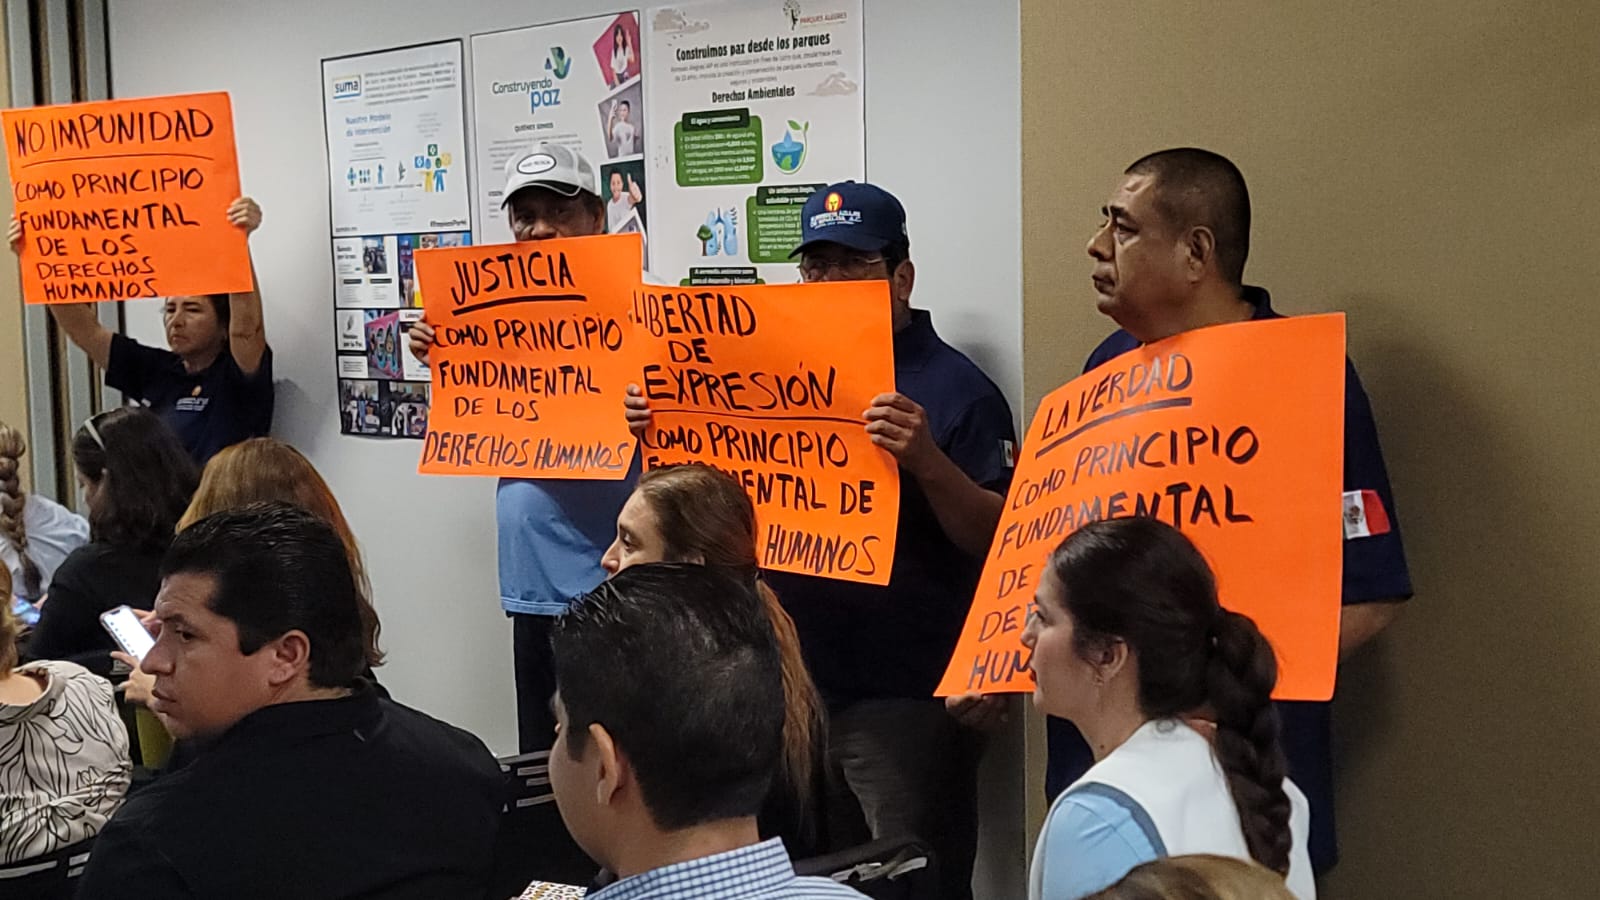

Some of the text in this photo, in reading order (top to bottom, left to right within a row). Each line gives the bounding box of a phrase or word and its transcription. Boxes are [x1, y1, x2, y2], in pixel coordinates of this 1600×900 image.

[676, 45, 728, 61] Construimos
[730, 43, 745, 57] paz
[748, 38, 774, 54] desde
[777, 36, 790, 50] los
[793, 33, 830, 48] parques
[335, 80, 359, 93] suma
[492, 76, 552, 94] Construyendo
[531, 89, 561, 114] paz
[712, 85, 795, 103] Derechos Ambientales
[15, 108, 213, 157] NO IMPUNIDAD
[15, 168, 203, 202] COMO PRINCIPIO
[20, 203, 200, 235] FUNDAMENTAL
[37, 234, 138, 256] DE LOS
[36, 256, 155, 280] DERECHOS
[451, 251, 575, 306] JUSTICIA
[44, 278, 159, 300] HUMANOS
[632, 289, 757, 337] LIBERTAD
[432, 312, 623, 351] COMO PRINCIPIO
[668, 338, 713, 363] DE
[438, 360, 602, 398] FUNDAMENTAL
[643, 361, 836, 411] EXPRESIÓN
[455, 397, 540, 421] DE LOS
[1041, 353, 1193, 442] LA VERDAD
[422, 430, 629, 473] DERECHOS HUMANOS
[641, 421, 848, 468] COMO PRINCIPIO
[1071, 425, 1260, 487] PRINCIPIO
[840, 480, 875, 515] DE
[764, 524, 881, 576] HUMANOS
[997, 564, 1033, 600] DE
